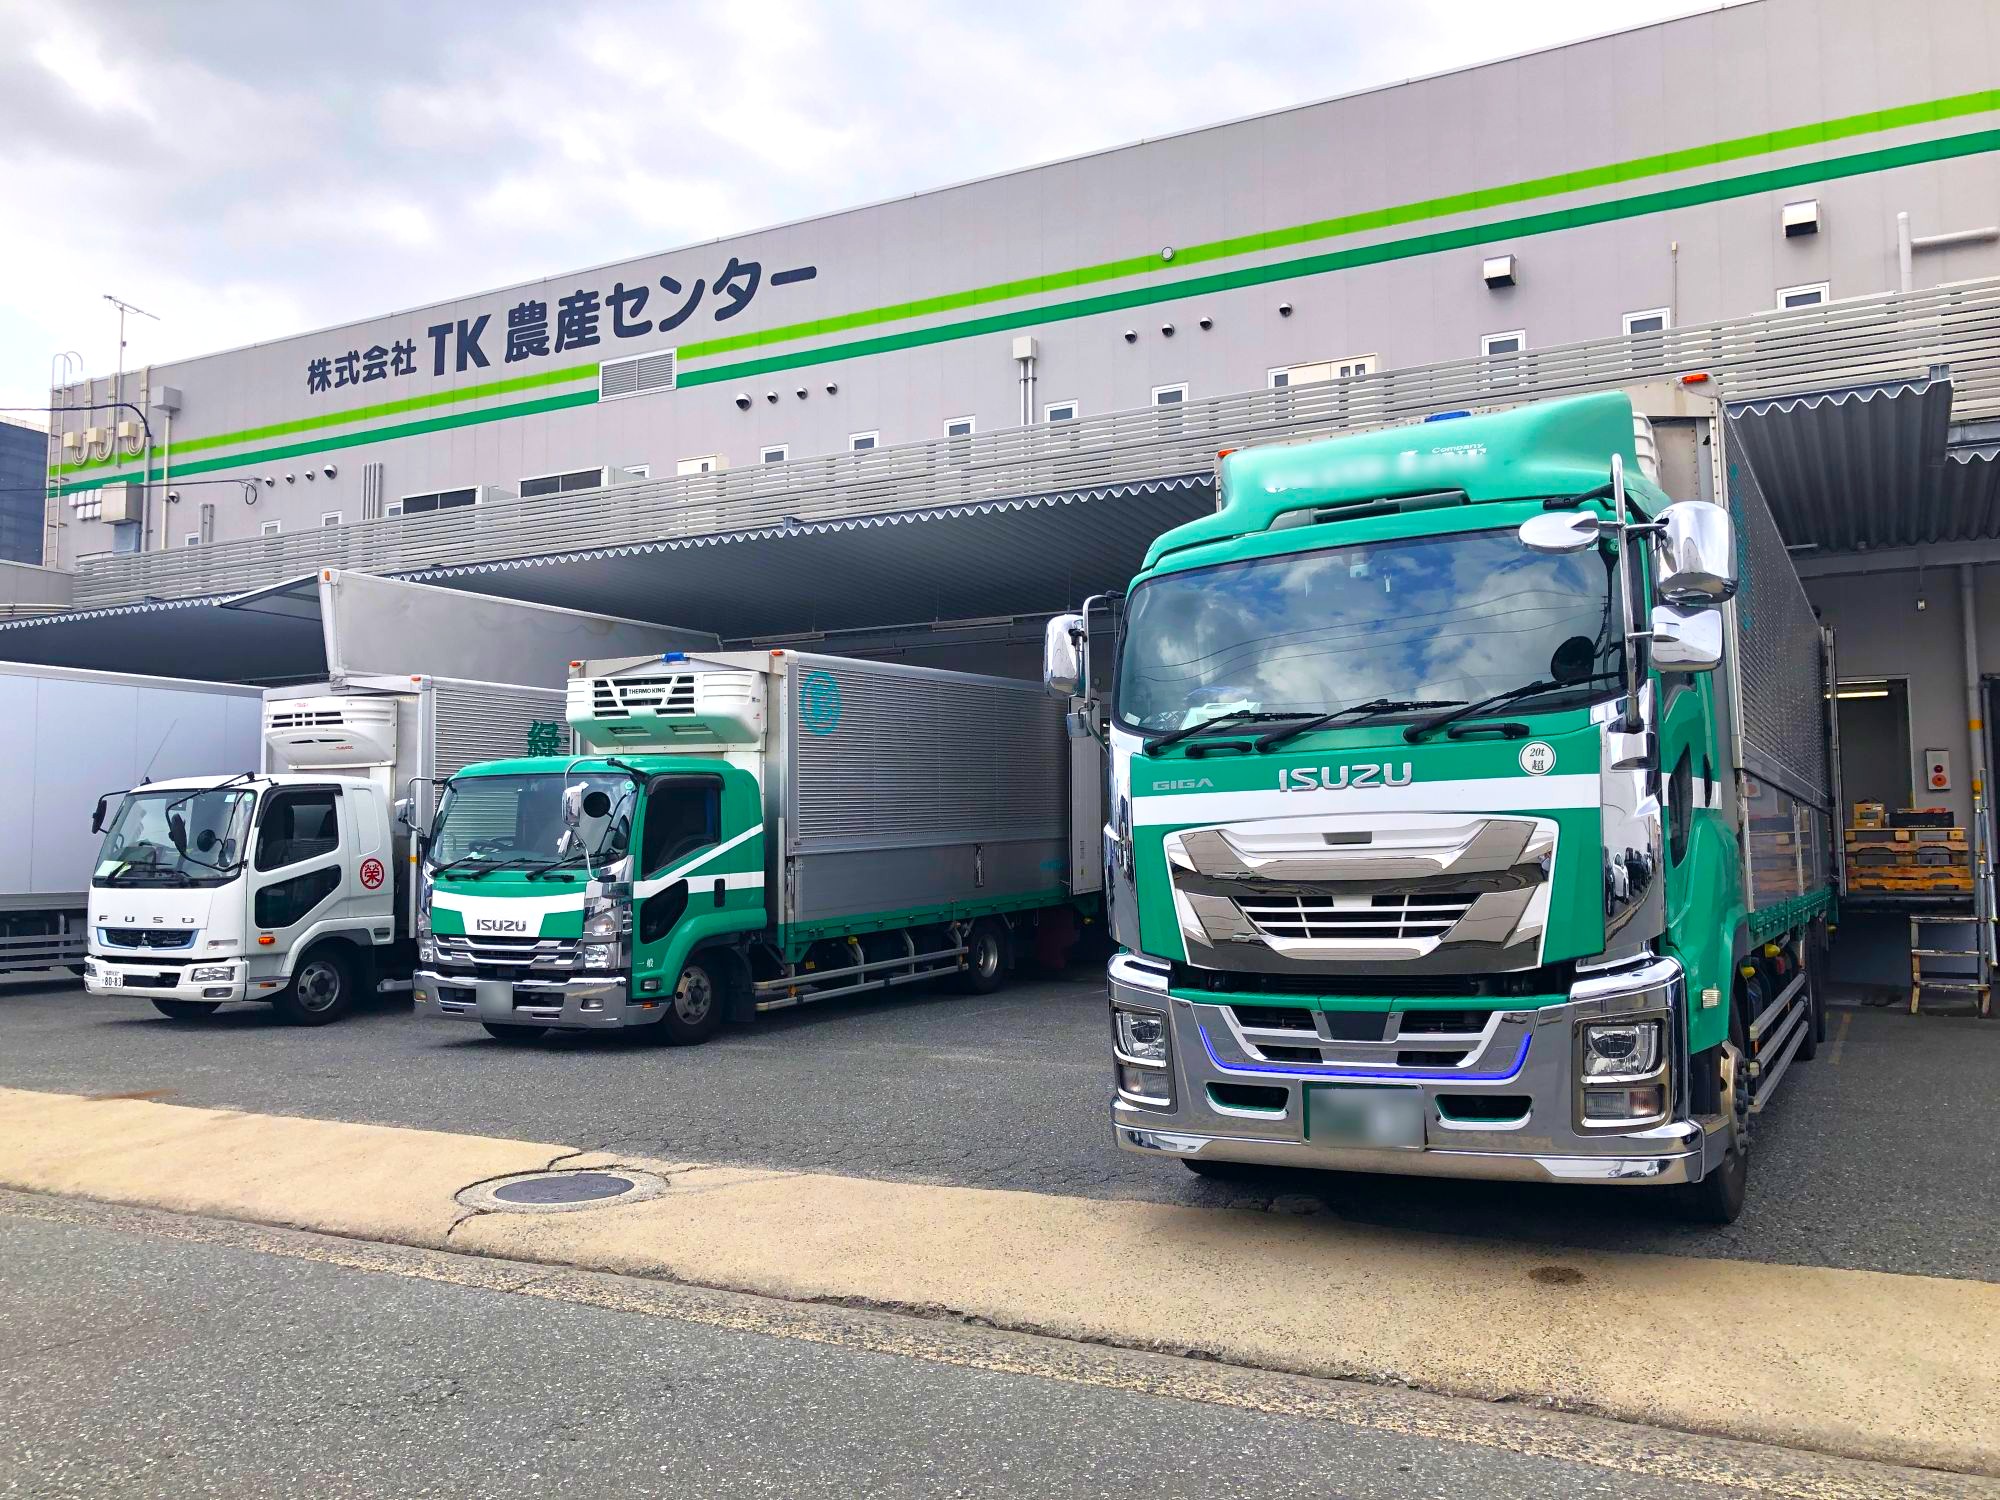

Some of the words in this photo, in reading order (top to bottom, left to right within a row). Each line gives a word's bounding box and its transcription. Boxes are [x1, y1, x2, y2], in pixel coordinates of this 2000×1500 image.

[307, 338, 417, 395] 株式会社
[428, 313, 492, 377] TK
[504, 257, 817, 363] 農産センター
[1432, 443, 1484, 454] Company
[527, 719, 570, 758] 緑
[1530, 748, 1545, 757] 20t
[1532, 759, 1544, 771] 超
[1279, 762, 1412, 792] ISUZU
[1152, 777, 1214, 791] GIGA
[98, 915, 195, 924] FUSO
[476, 919, 527, 932] ISUZU
